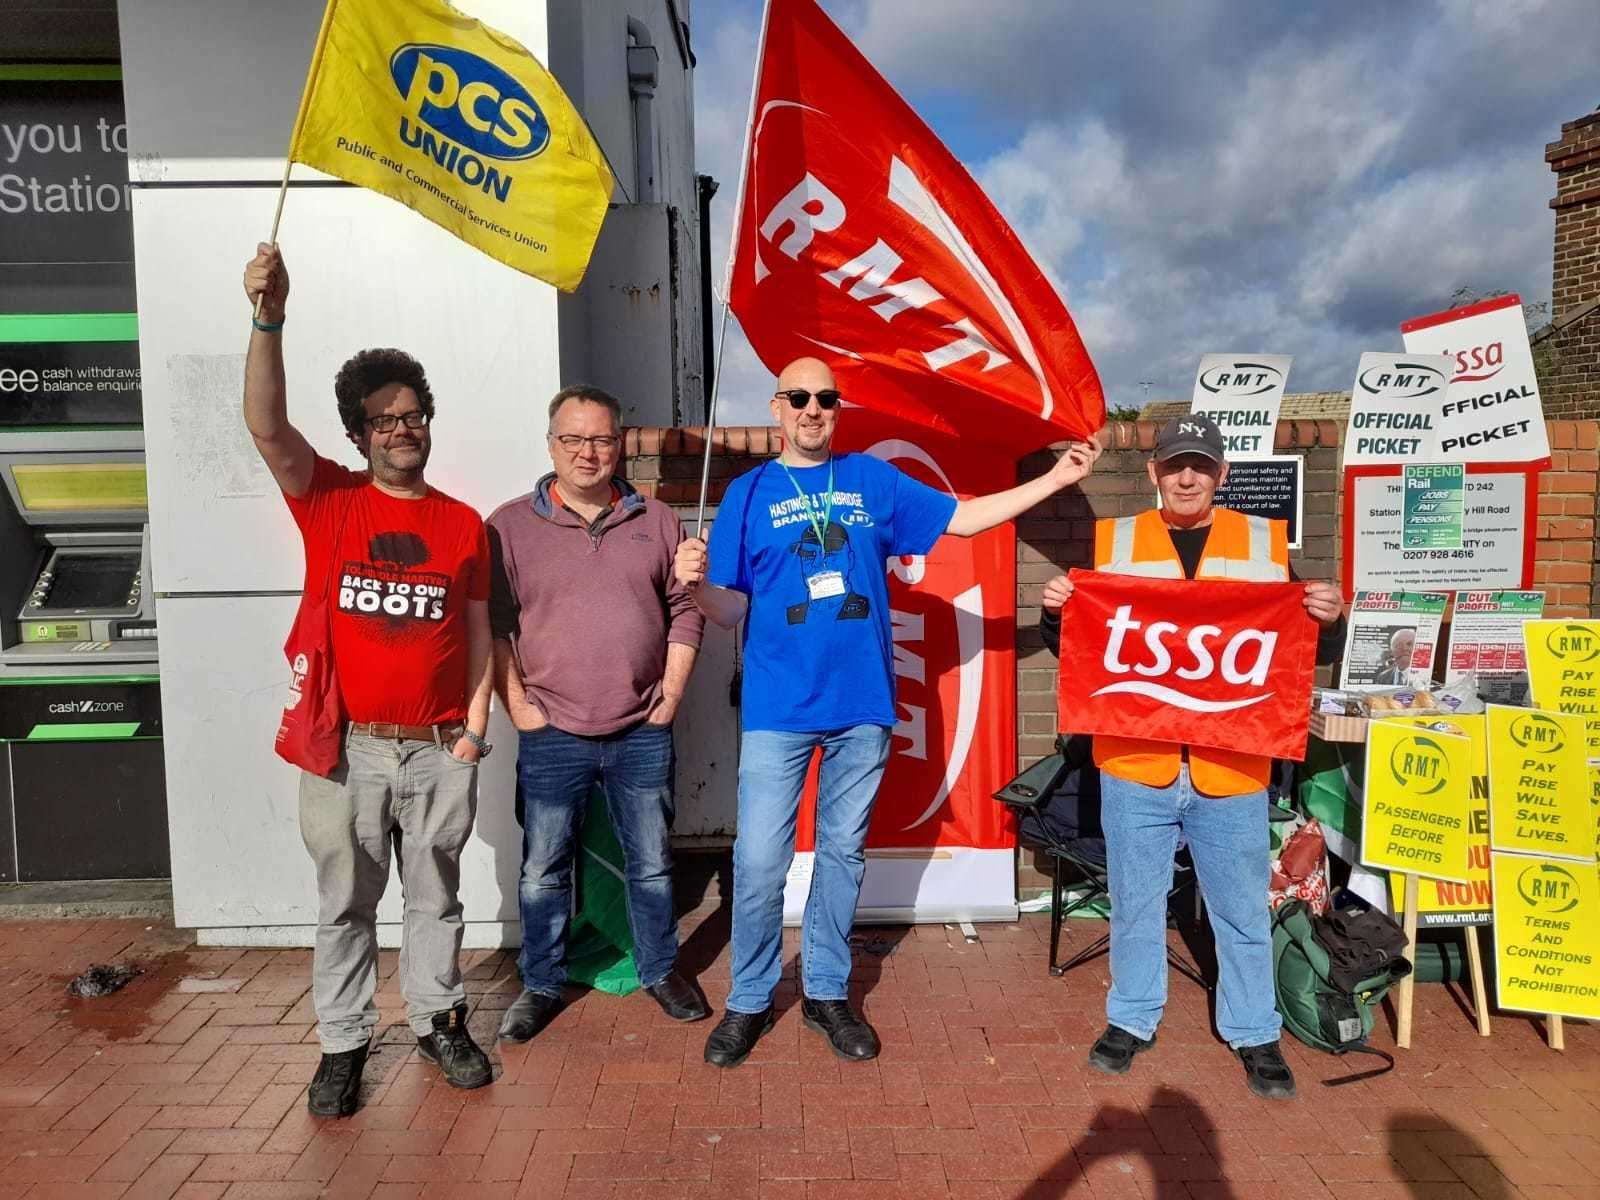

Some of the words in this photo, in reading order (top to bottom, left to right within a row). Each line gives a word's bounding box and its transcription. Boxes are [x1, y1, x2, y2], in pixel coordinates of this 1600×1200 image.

[403, 52, 537, 148] pcs
[2, 123, 82, 163] you
[400, 116, 513, 203] UNION
[337, 136, 376, 161] Public
[379, 155, 403, 174] and
[406, 168, 467, 216] Commercial
[466, 209, 511, 239] Services
[513, 231, 549, 254] Union
[760, 170, 1012, 373] RMT
[42, 368, 73, 379] cash
[1216, 373, 1268, 386] RMT
[1376, 373, 1431, 388] RMT
[43, 380, 94, 392] balance
[1352, 412, 1434, 430] OFFICIAL
[1177, 421, 1207, 438] NY
[1442, 420, 1530, 453] PICKET
[1357, 438, 1421, 455] PICKET
[1230, 467, 1258, 475] personal
[1259, 467, 1279, 475] safety
[1406, 466, 1462, 478] DEFEND
[1408, 478, 1431, 489] Rail
[1476, 483, 1494, 491] 242
[1421, 491, 1449, 499] JOBS
[1418, 503, 1439, 511] PAY
[1472, 506, 1485, 515] Hill
[1487, 505, 1510, 514] Road
[1383, 542, 1400, 550] The
[1403, 551, 1428, 560] 0207
[1430, 551, 1449, 559] 928
[1451, 550, 1474, 559] 4616
[341, 574, 383, 591] BACK
[386, 582, 411, 595] TO
[414, 584, 447, 599] OUR
[338, 587, 444, 620] ROOTS
[1367, 591, 1391, 601] CUT
[1468, 592, 1491, 602] CUT
[1356, 601, 1399, 609] PROFITS
[1457, 602, 1499, 610] PROFITS
[1102, 604, 1280, 687] tssa
[1559, 636, 1592, 651] RMT
[1561, 670, 1594, 681] PAY
[1559, 686, 1597, 697] RISE
[1558, 702, 1599, 714] WILL
[1523, 726, 1557, 743] RMT
[1403, 752, 1440, 780] RMT
[1522, 759, 1556, 773] PAY
[1518, 775, 1559, 791] RISE
[1516, 791, 1558, 808] WILL
[1374, 802, 1462, 830] PASSENGERS
[1516, 809, 1561, 825] SAVE
[1390, 824, 1446, 845] BEFORE
[1516, 826, 1569, 844] LIVES.
[1386, 842, 1442, 864] PROFITS
[1532, 878, 1570, 900] RMT
[1524, 915, 1571, 931] TERMS
[1531, 932, 1563, 945] AND
[1505, 945, 1593, 965] CONDITIONS
[1533, 964, 1564, 977] NOT
[1507, 976, 1598, 997] PROHIBITION
